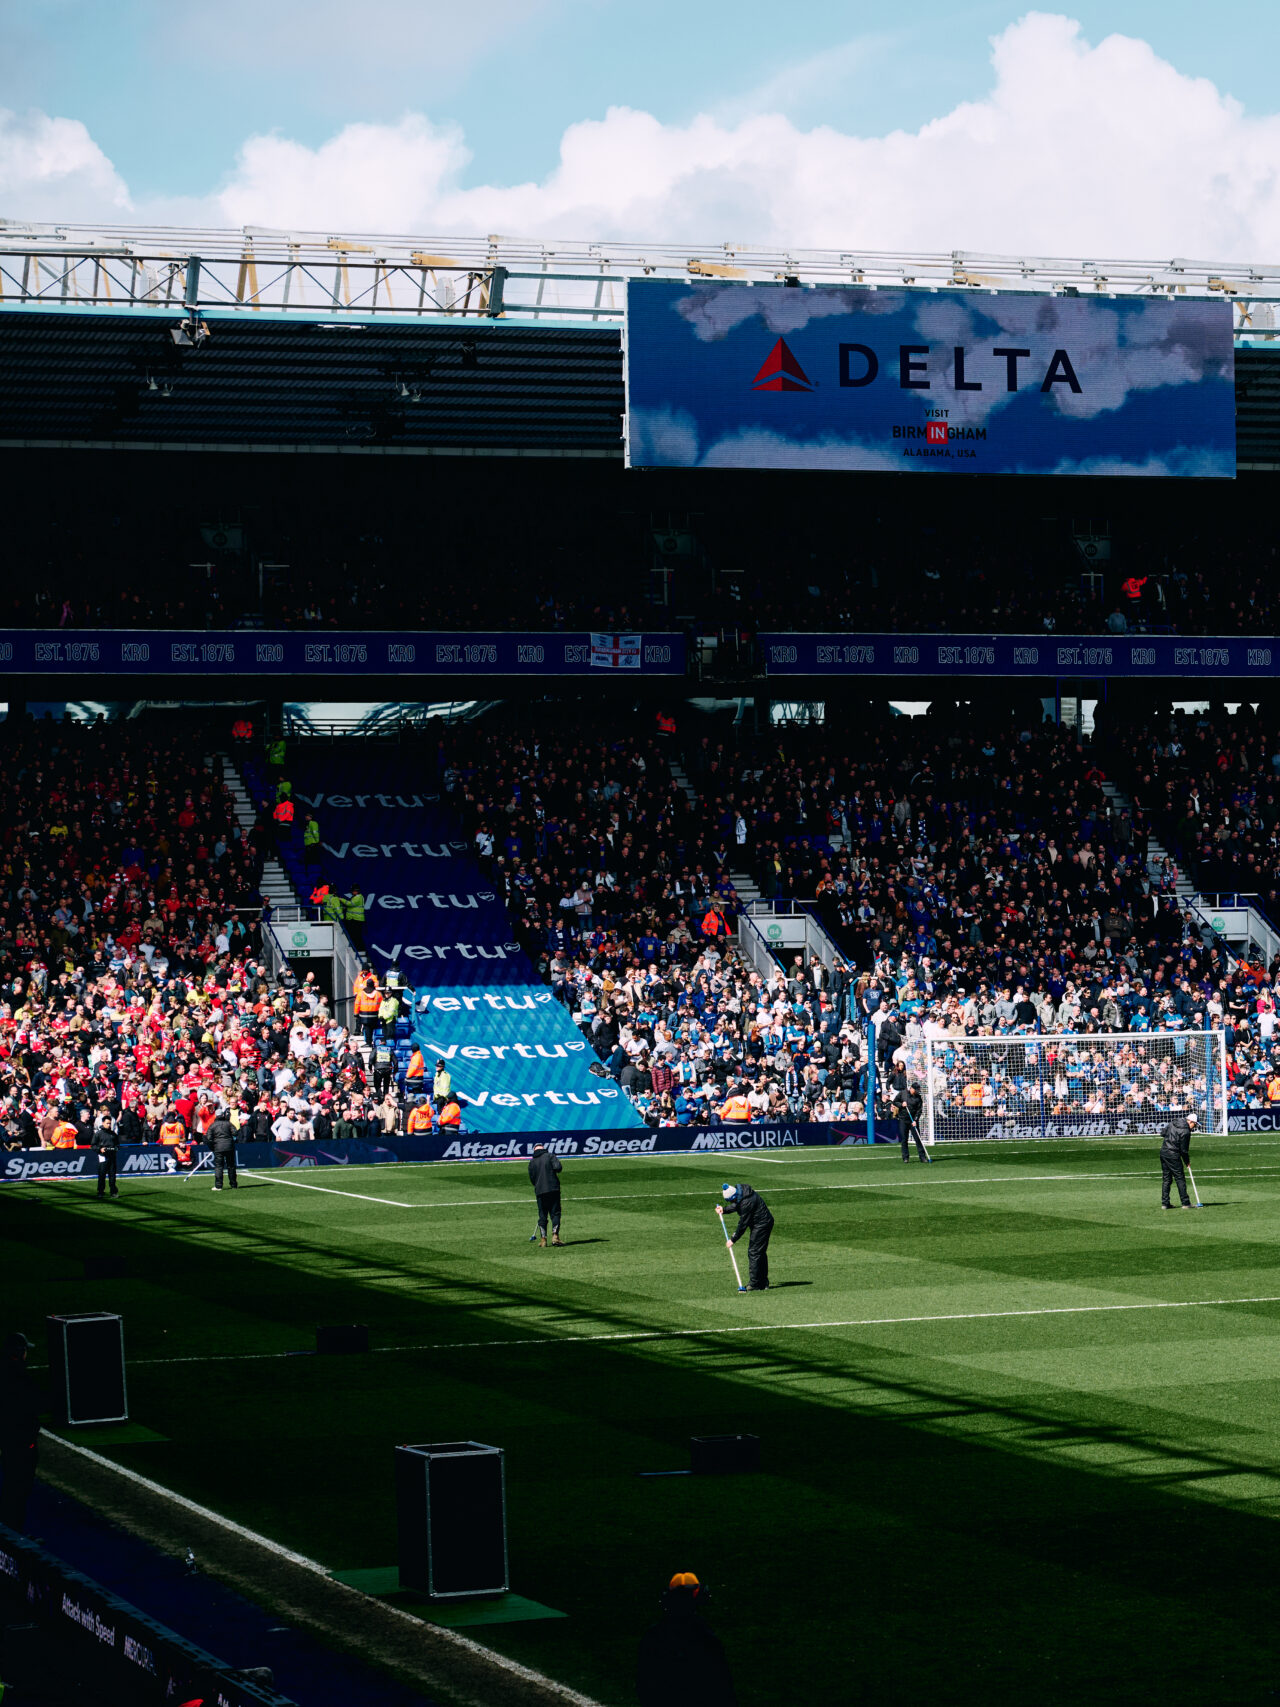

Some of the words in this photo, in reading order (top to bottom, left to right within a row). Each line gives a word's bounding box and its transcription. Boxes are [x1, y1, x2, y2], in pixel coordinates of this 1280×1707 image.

[838, 343, 1083, 393] DELTA
[925, 409, 949, 418] VISIT
[892, 425, 987, 443] BIRMINGHAM
[903, 447, 955, 458] ALABAMA,
[956, 449, 977, 458] USA
[35, 643, 100, 661] EST.1875
[121, 644, 150, 661] KRO
[170, 643, 235, 662] EST.1875
[256, 644, 284, 662] KRO
[304, 644, 368, 663] EST.1875
[388, 644, 416, 663] KRO
[436, 645, 498, 663] EST.1875
[517, 645, 544, 663] KRO
[645, 645, 671, 663] KRO
[771, 645, 798, 663] KRO
[816, 646, 875, 663] EST.1875
[893, 646, 919, 664] KRO
[938, 646, 995, 664] EST.1875
[1013, 647, 1039, 664] KRO
[1057, 647, 1113, 665] EST.1875
[1131, 648, 1156, 665] KRO
[1174, 648, 1230, 666] EST.1875
[1247, 649, 1272, 666] KRO
[295, 793, 424, 809] vertu
[320, 842, 452, 859] vertu
[372, 942, 509, 960] vertu
[425, 1042, 566, 1061] vertu
[457, 1089, 600, 1108] vertu
[1064, 1119, 1110, 1137] with
[442, 1140, 521, 1159] Attack
[581, 1134, 658, 1155] Speed
[691, 1129, 804, 1149] MERCURIAL
[5, 1155, 86, 1179] Speed
